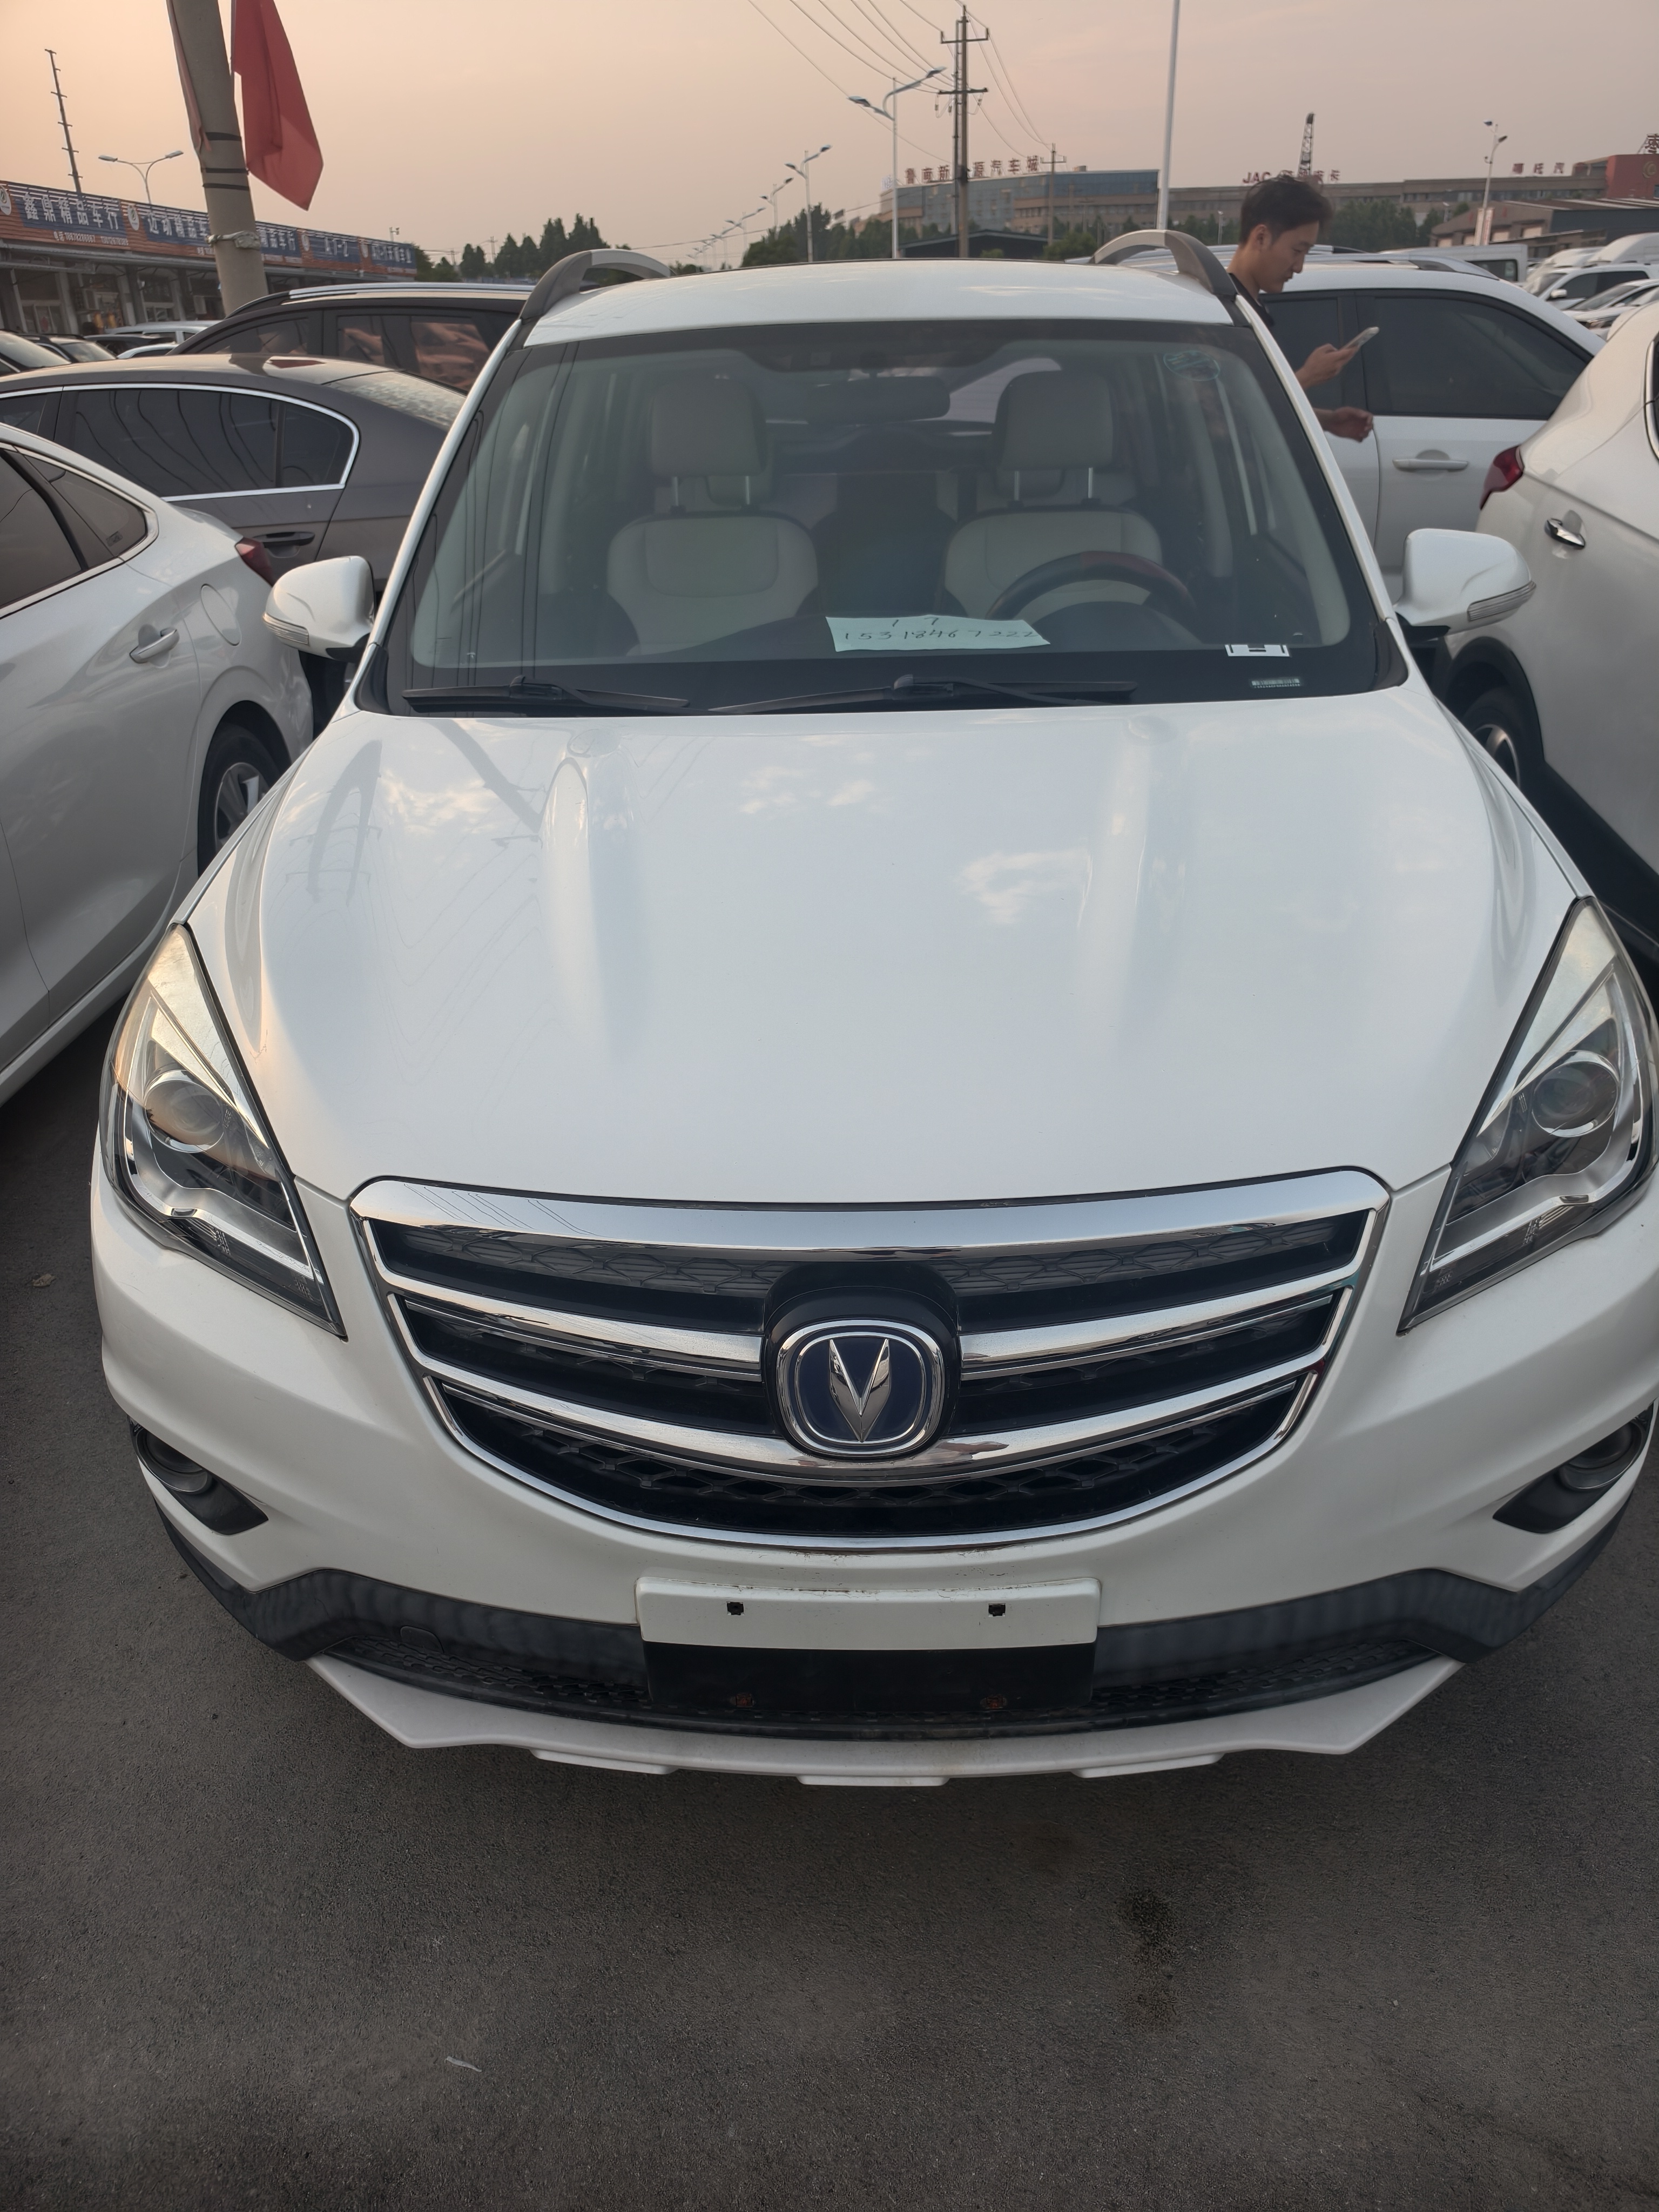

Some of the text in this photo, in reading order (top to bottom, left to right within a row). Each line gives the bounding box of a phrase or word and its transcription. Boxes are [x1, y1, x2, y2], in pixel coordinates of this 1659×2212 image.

[905, 156, 1039, 184] 鲁南新源汽车城
[1243, 171, 1271, 183] JAC
[23, 192, 119, 230] 鑫鼎精品车行
